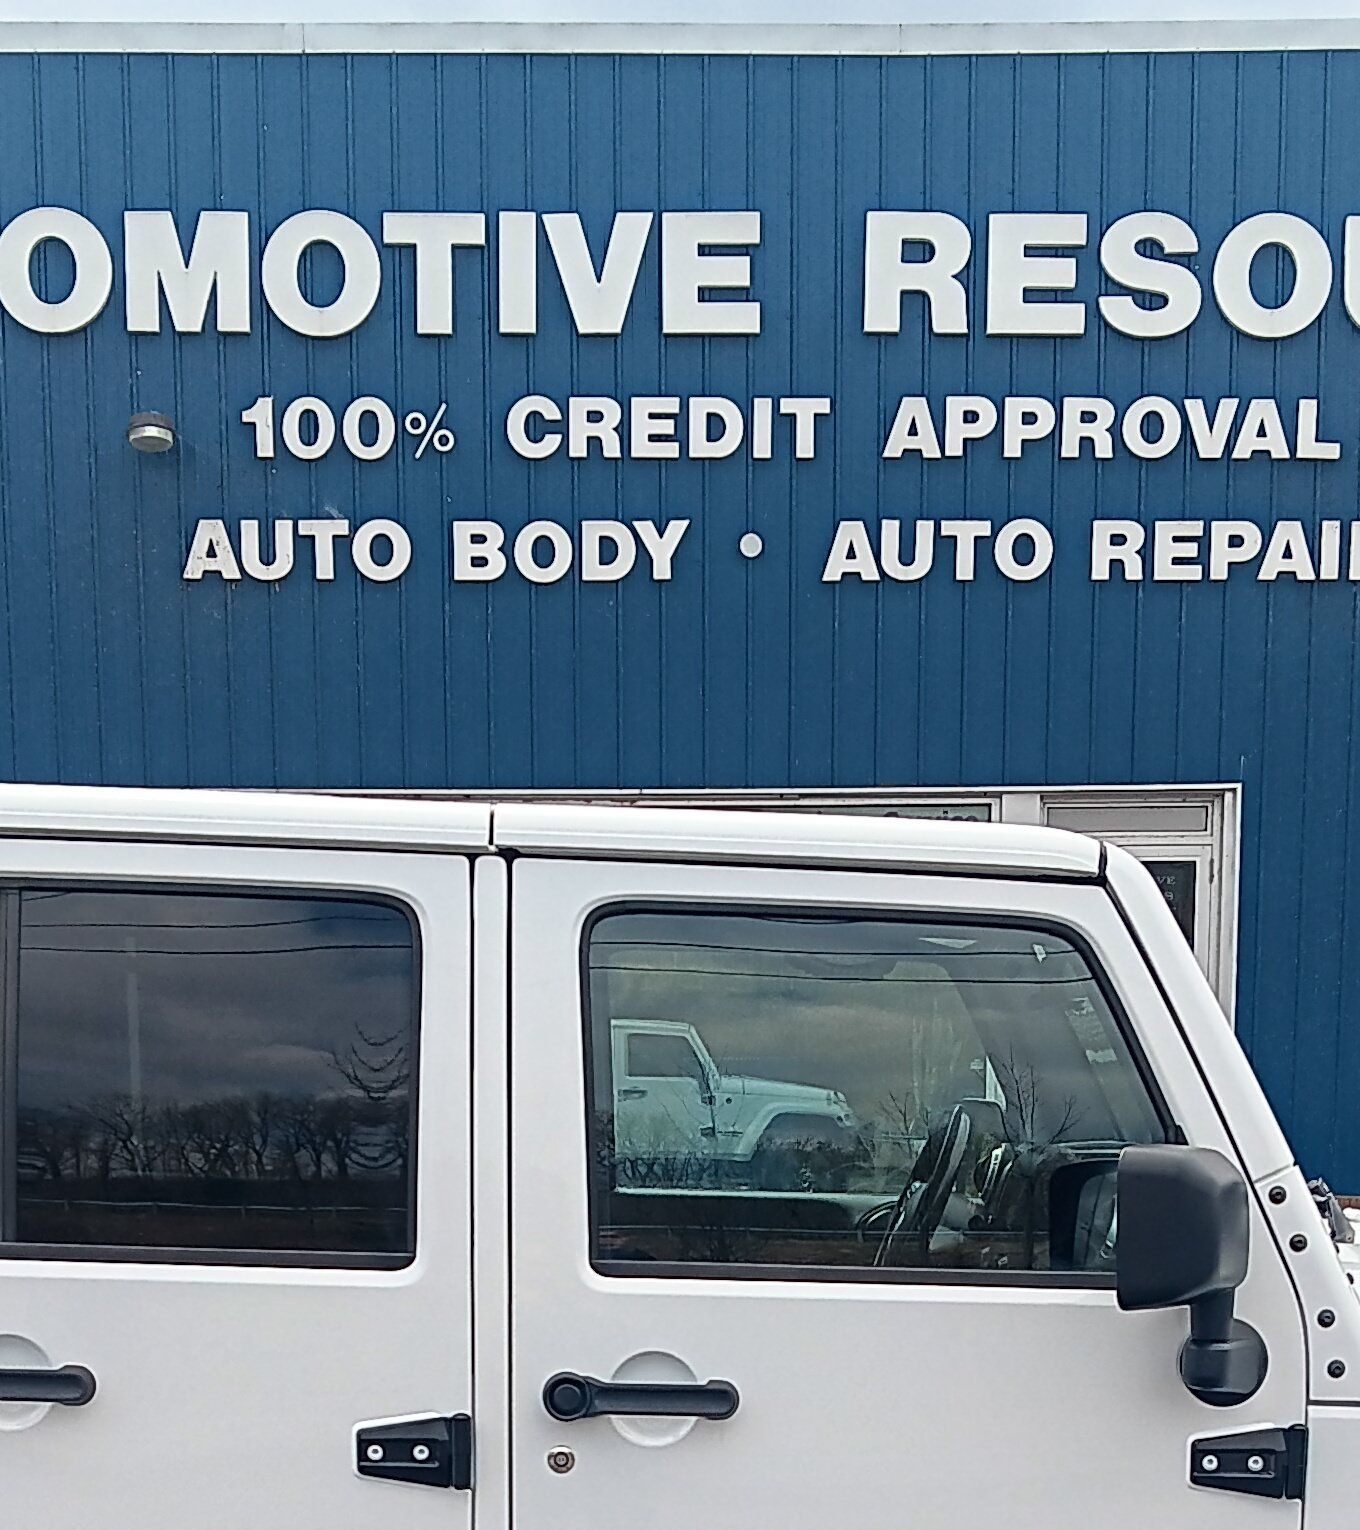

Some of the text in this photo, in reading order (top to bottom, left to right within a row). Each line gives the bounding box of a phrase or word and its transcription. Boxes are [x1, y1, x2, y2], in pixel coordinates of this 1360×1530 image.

[240, 395, 1342, 461] 100% CREDIT APPROVAL
[182, 518, 412, 582] AUTO
[452, 518, 691, 583] BODY
[821, 518, 1055, 583] AUTO
